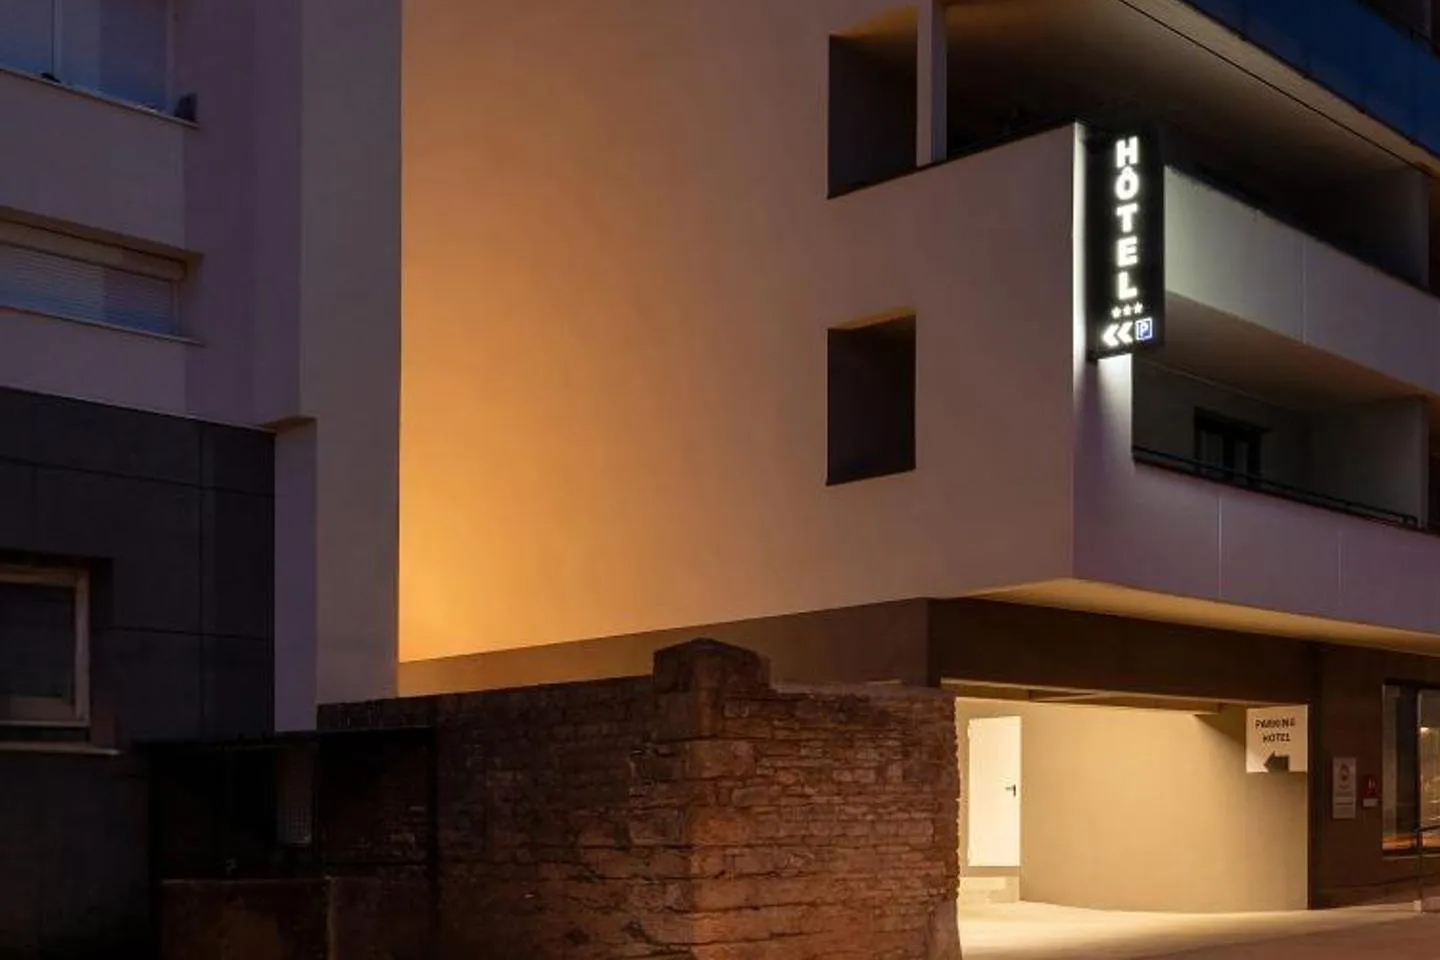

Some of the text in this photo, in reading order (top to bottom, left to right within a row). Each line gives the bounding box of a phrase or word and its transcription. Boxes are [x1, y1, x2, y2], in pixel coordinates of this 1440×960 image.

[1115, 136, 1139, 300] HÔTEL
[1139, 321, 1149, 338] P
[1255, 718, 1295, 729] PARKING
